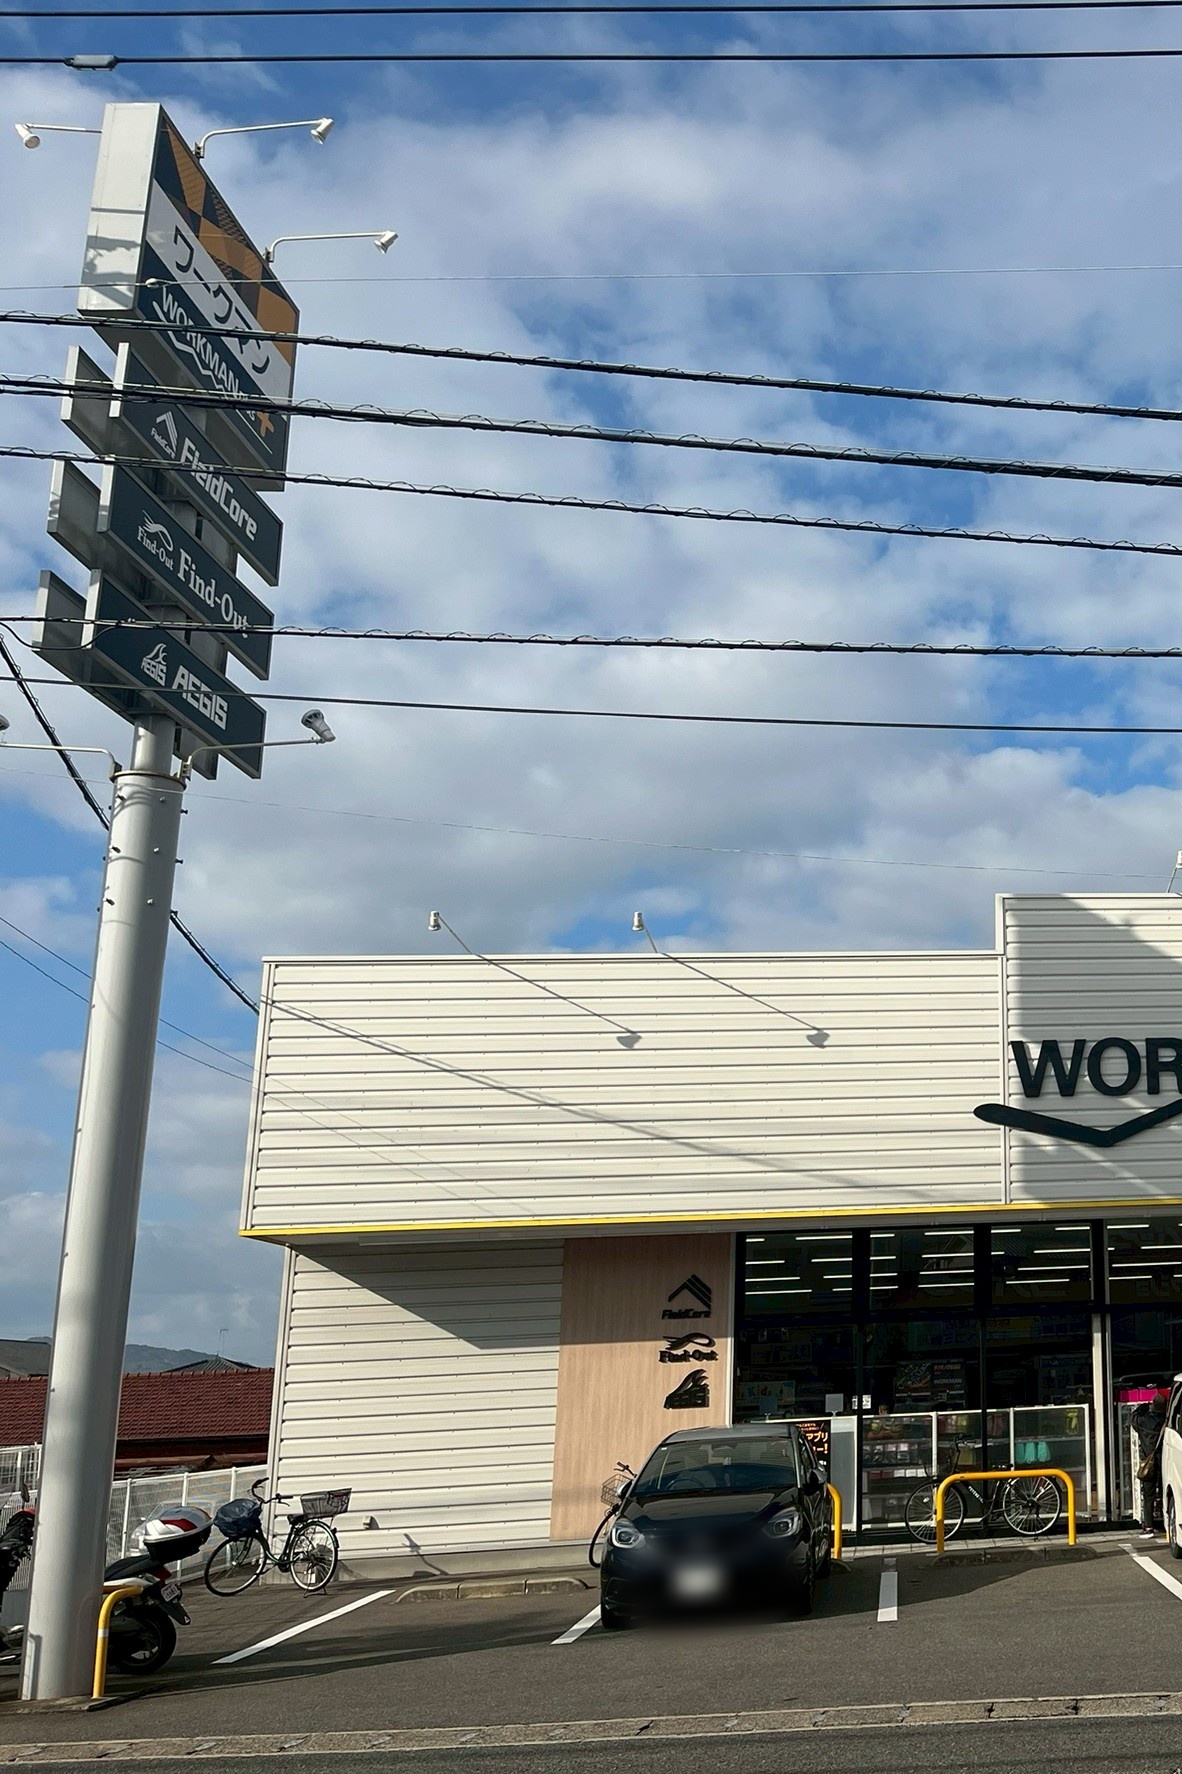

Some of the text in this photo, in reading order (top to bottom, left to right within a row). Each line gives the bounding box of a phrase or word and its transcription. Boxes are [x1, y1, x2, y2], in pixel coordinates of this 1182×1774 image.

[180, 436, 259, 542] FieldCore
[136, 525, 174, 571] Find-Out
[177, 548, 250, 639] Find-Out
[141, 656, 167, 687] AEGIS
[171, 664, 229, 731] AEGIS
